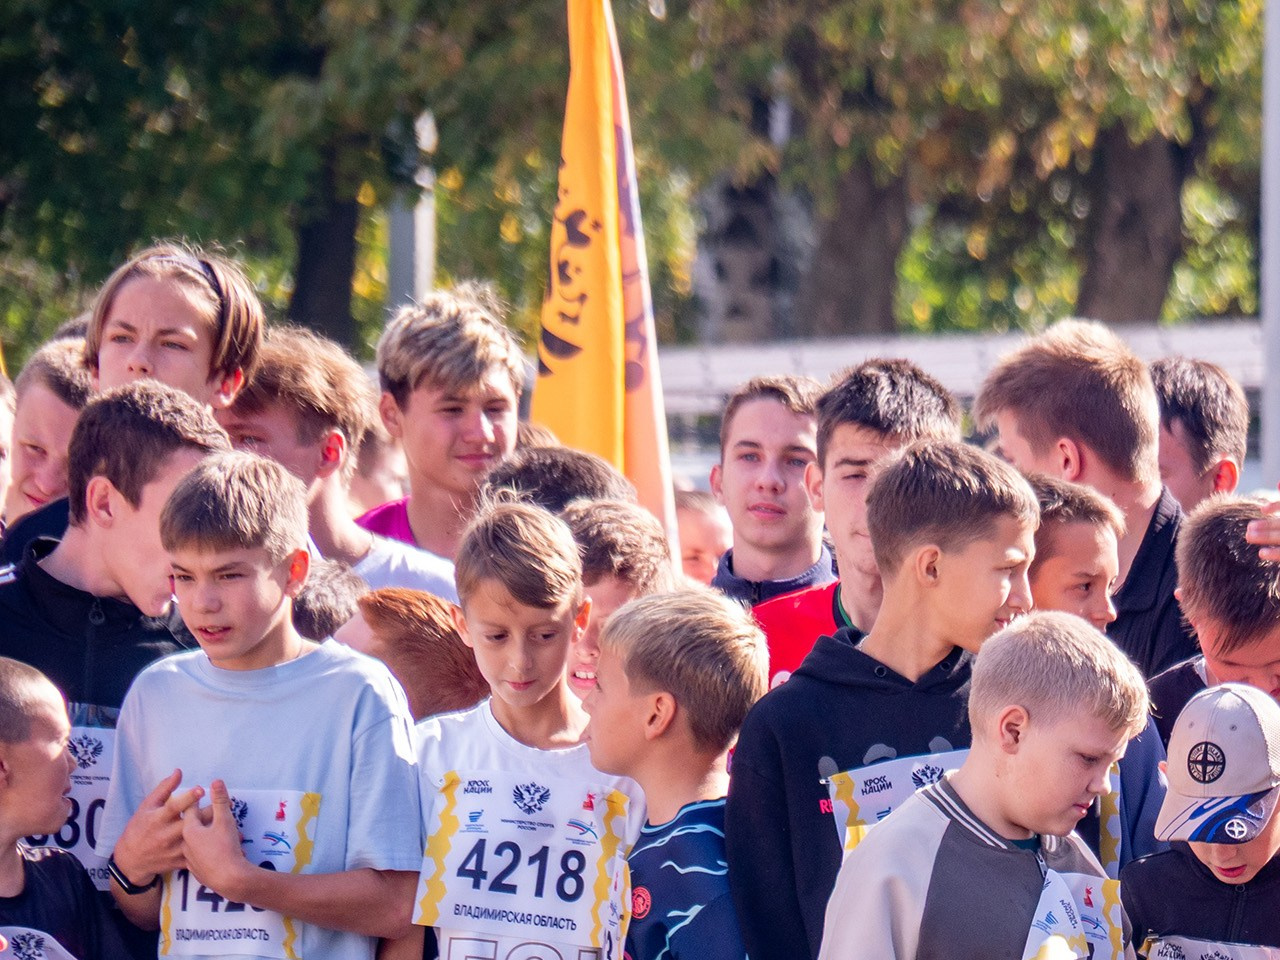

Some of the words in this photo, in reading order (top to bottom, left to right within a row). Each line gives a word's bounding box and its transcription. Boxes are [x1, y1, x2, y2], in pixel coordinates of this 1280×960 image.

[467, 780, 490, 788] КРОСС
[863, 776, 887, 787] КРОСС
[463, 786, 493, 795] НАЦИИ
[861, 783, 893, 796] НАЦИИ
[456, 838, 587, 903] 4218
[453, 904, 533, 928] ВЛАДИМИРСКАЯ
[532, 912, 578, 932] ОБЛАСТЬ
[175, 928, 231, 941] ВЛАДИМИРСКАЯ
[231, 929, 270, 941] ОБЛАСТЬ
